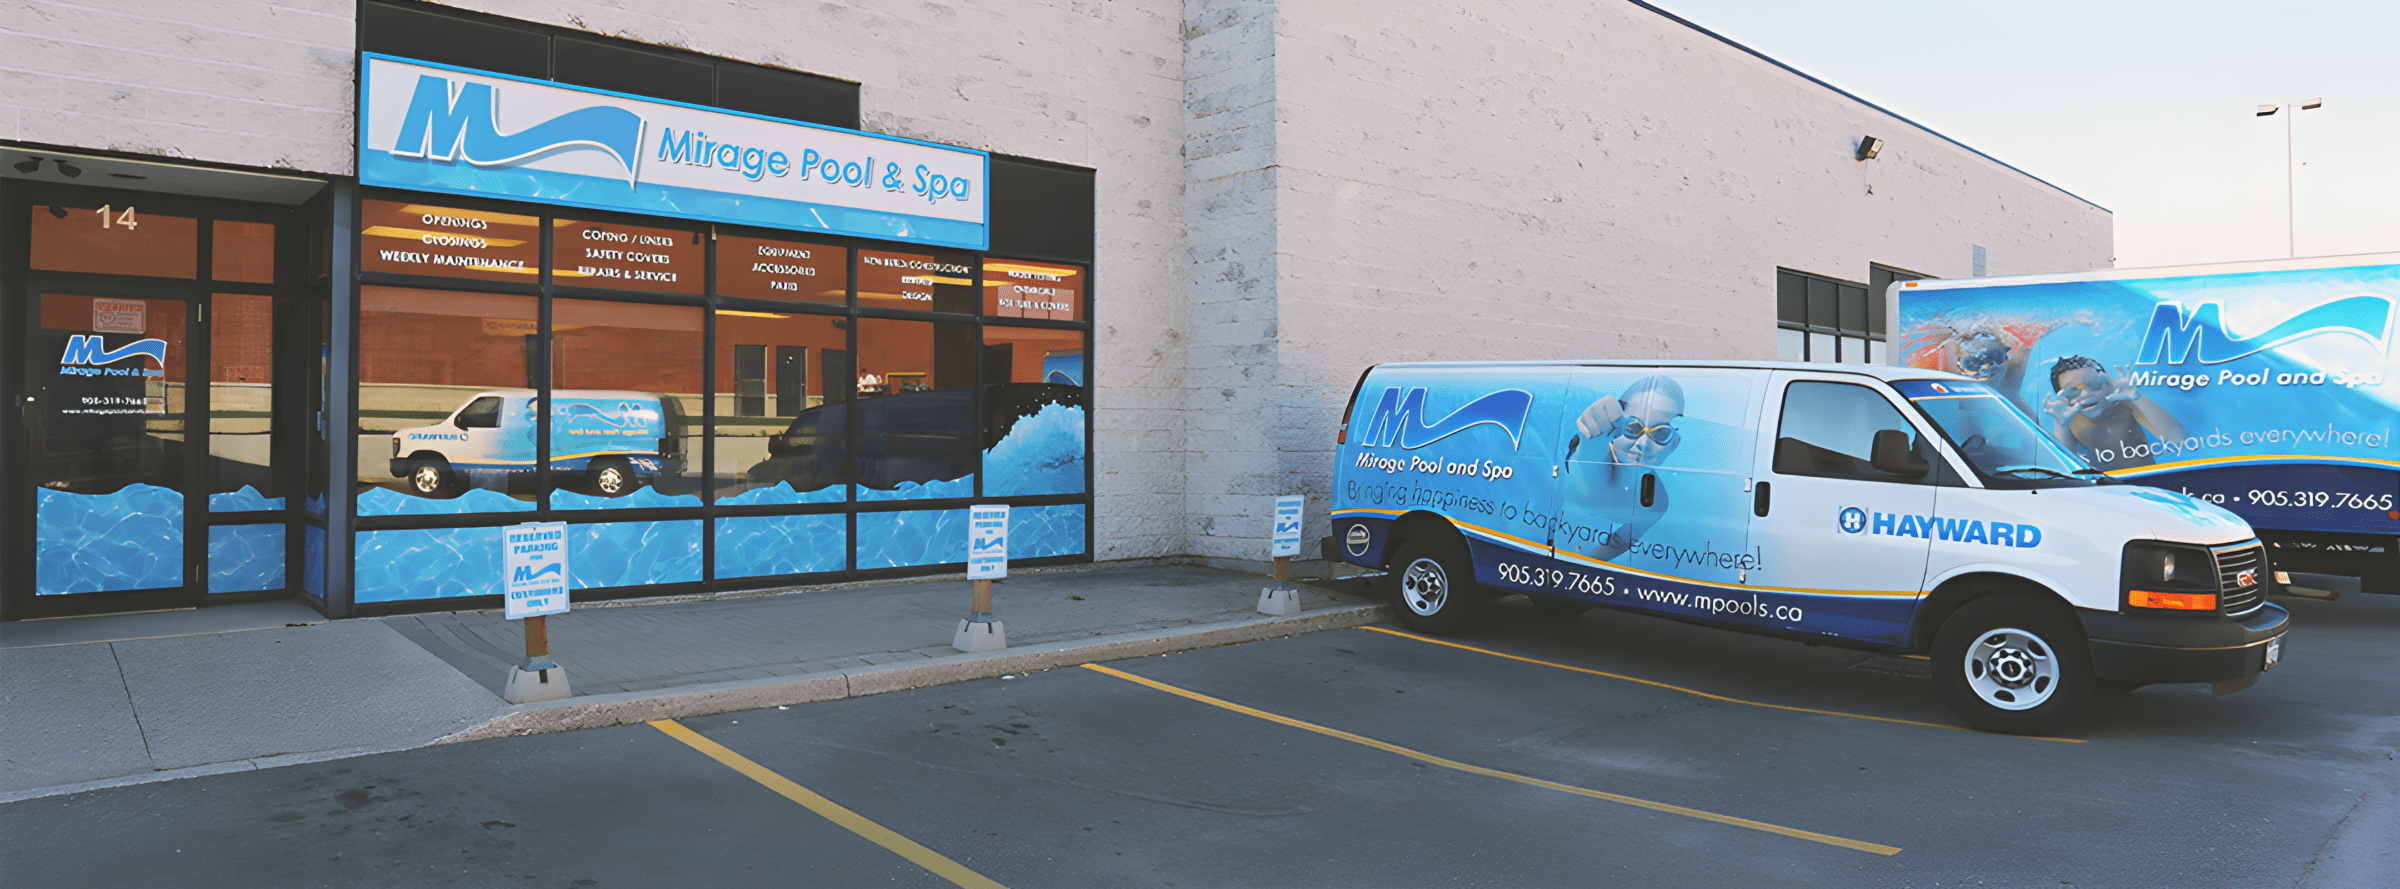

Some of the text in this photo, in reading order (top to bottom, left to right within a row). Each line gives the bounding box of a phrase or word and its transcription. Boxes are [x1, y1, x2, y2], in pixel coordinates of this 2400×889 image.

[658, 127, 970, 203] Mirage Pool & Spa
[96, 204, 138, 230] 14
[2129, 368, 2384, 391] Mirage Pool and Spa
[2120, 427, 2233, 460] backyards
[2240, 423, 2391, 449] everywhere!
[1355, 451, 1514, 481] Mirage Pool and Spa
[2248, 489, 2393, 511] 905.319.7665
[1412, 479, 1495, 515] happiness
[1523, 501, 1621, 548] backyards
[1628, 538, 1762, 571] everywhere!
[1872, 512, 2042, 548] HAYWARD
[1498, 562, 1803, 622] 905.319.7665 www.mpools.ca
